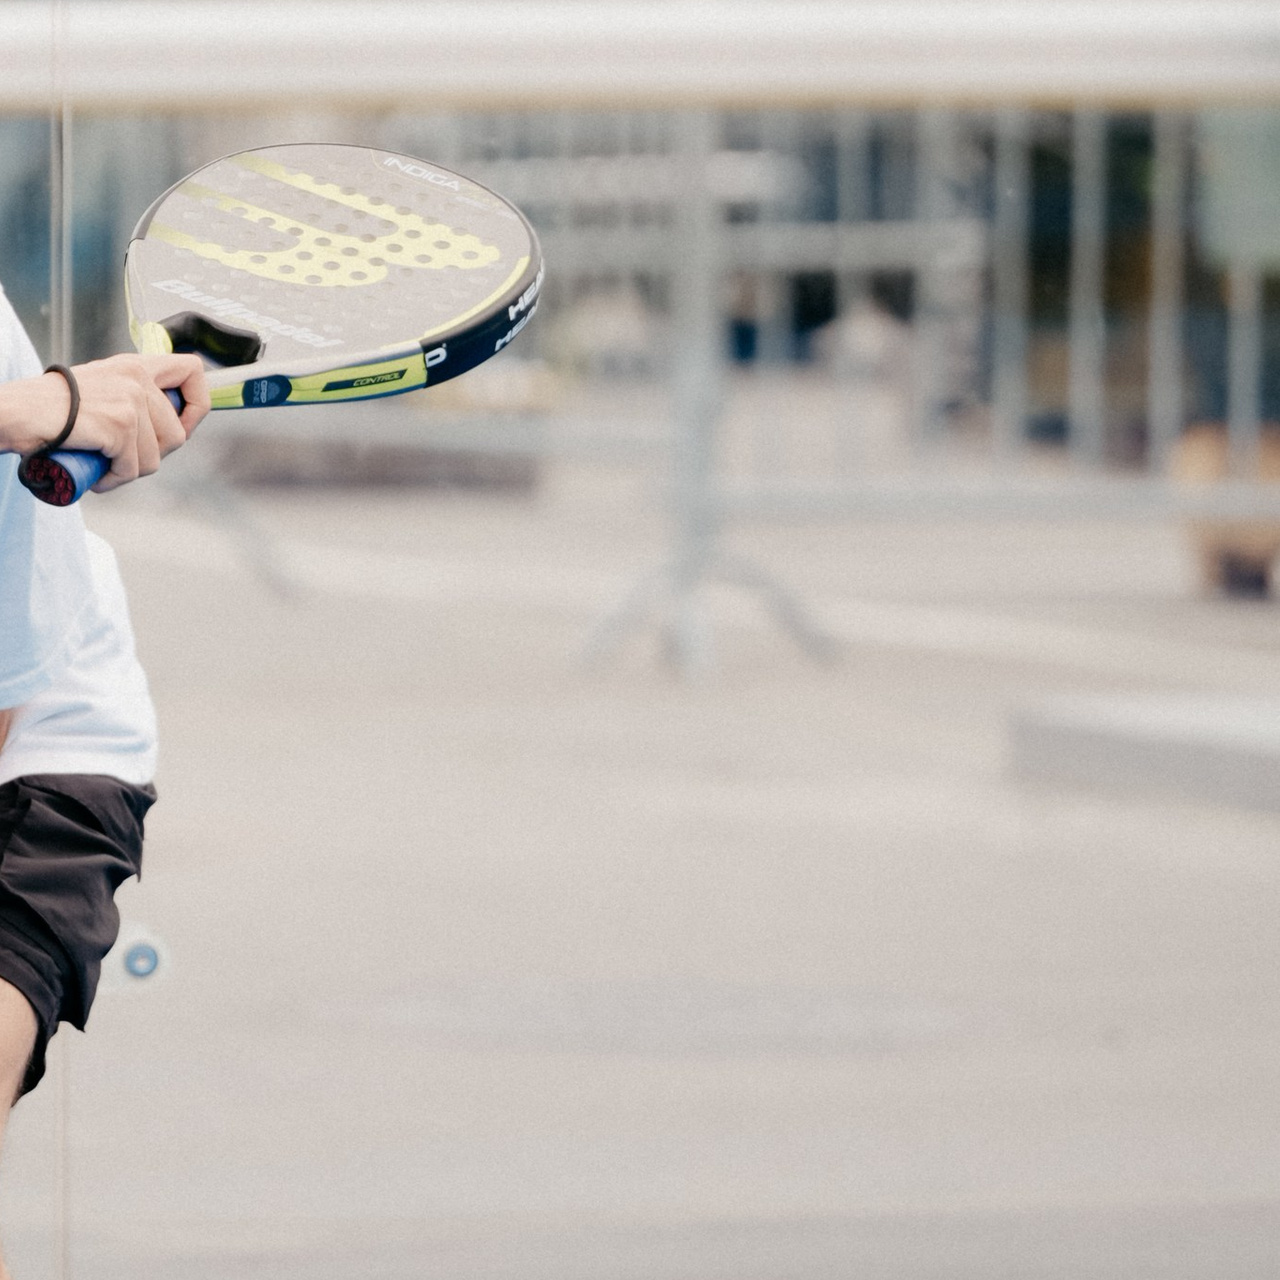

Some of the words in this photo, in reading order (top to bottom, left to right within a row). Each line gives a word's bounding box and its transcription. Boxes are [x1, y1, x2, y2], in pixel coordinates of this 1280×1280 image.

[384, 157, 460, 191] INDIGA
[508, 270, 544, 321] HEA
[494, 303, 538, 352] HEA
[353, 372, 401, 387] CONTROL
